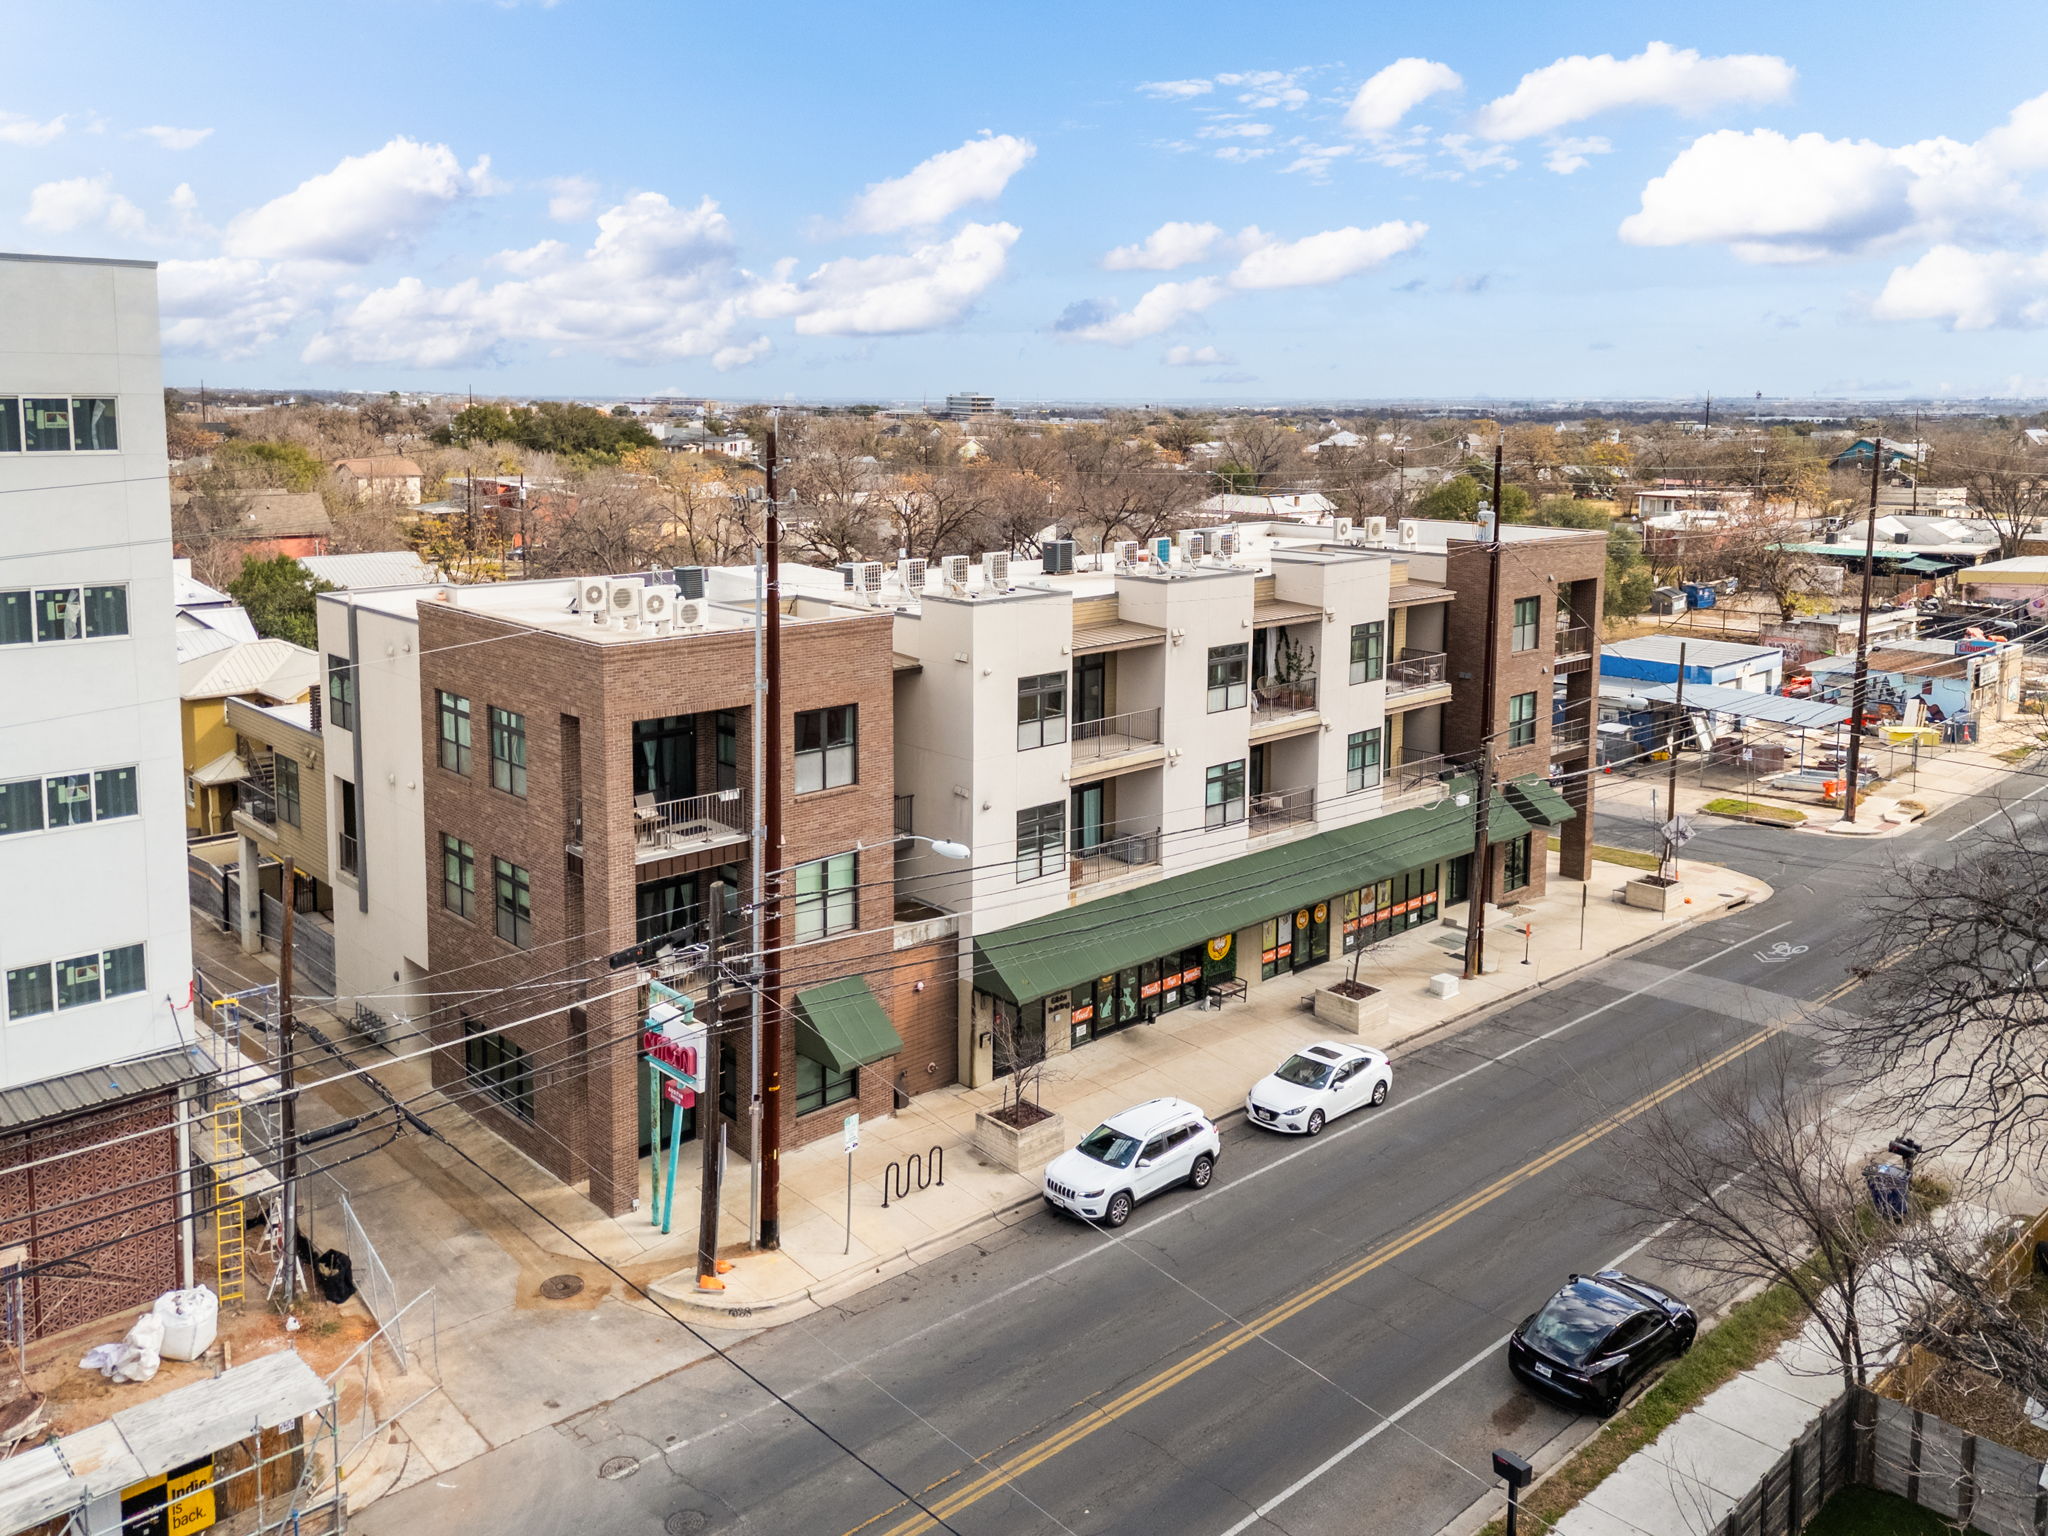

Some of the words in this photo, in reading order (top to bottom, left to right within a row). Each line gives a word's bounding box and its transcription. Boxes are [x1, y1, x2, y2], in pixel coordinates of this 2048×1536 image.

[171, 1479, 207, 1500] Indie
[172, 1503, 183, 1515] is
[173, 1507, 207, 1529] back.
